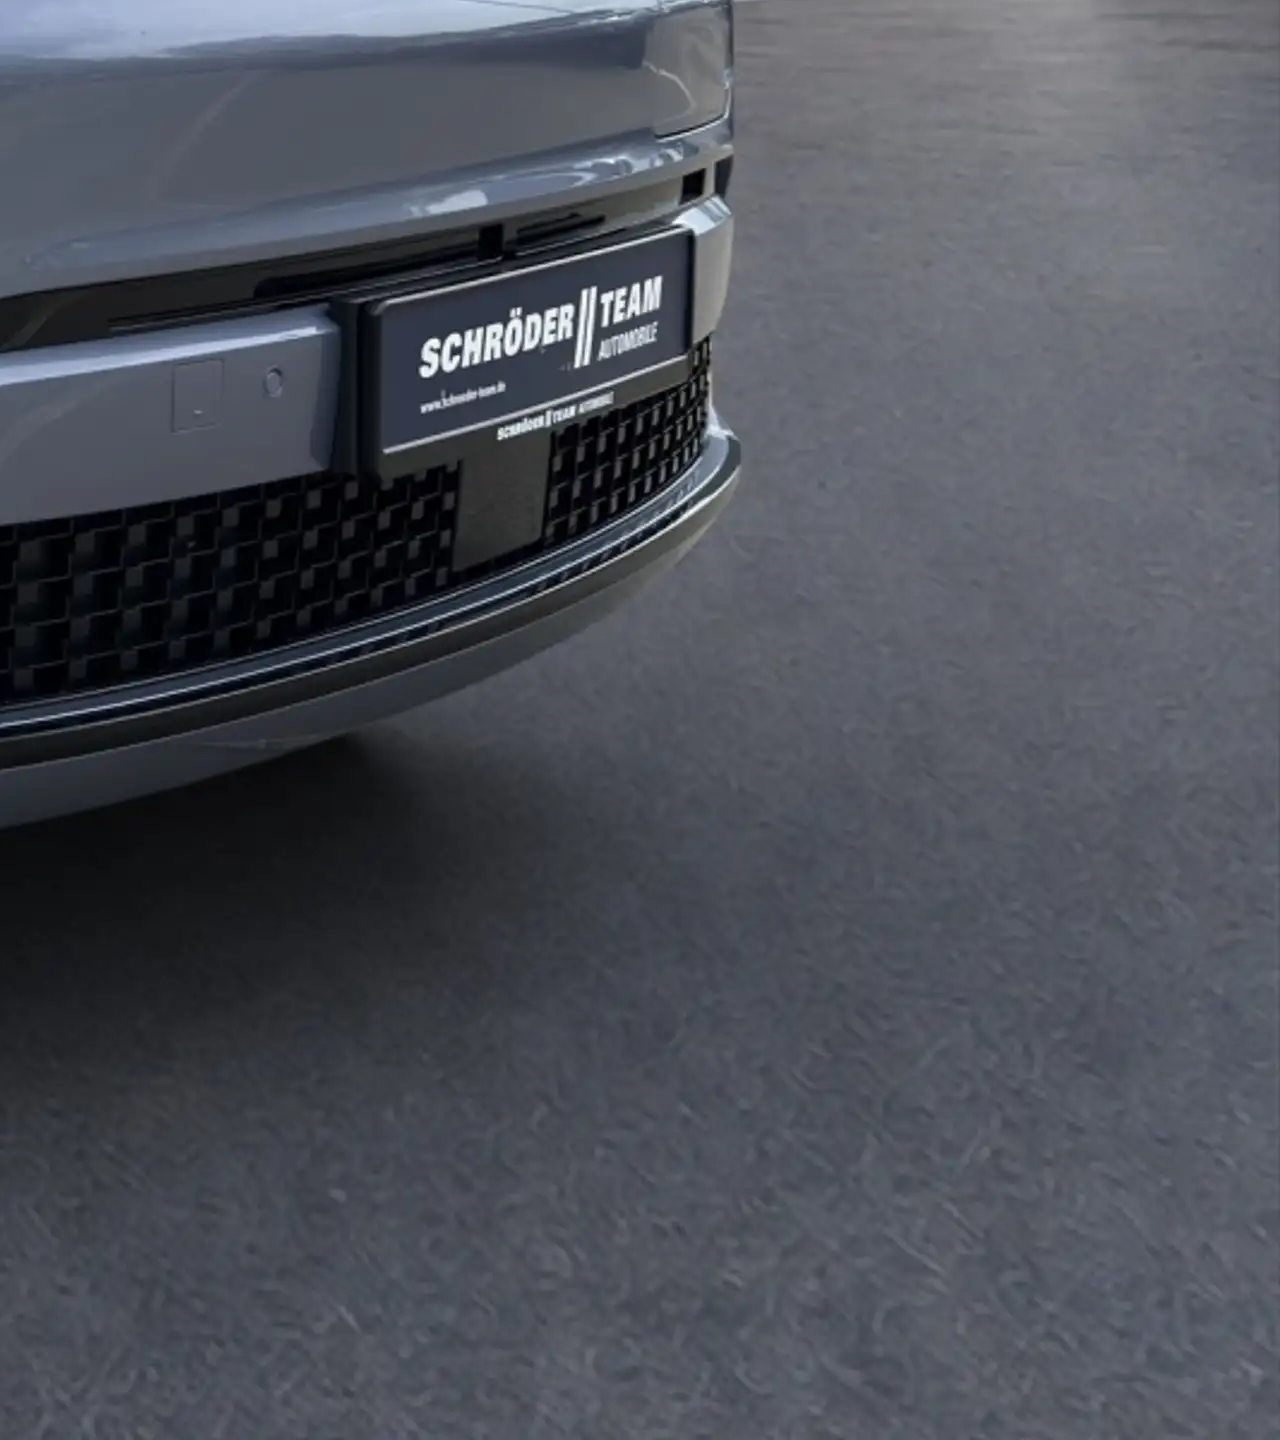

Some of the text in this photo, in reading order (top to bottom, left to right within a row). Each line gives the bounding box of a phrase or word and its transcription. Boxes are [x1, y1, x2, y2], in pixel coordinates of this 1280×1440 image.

[418, 275, 662, 378] SCHRÖDER TEAM
[597, 321, 658, 361] AUTOMOBILE
